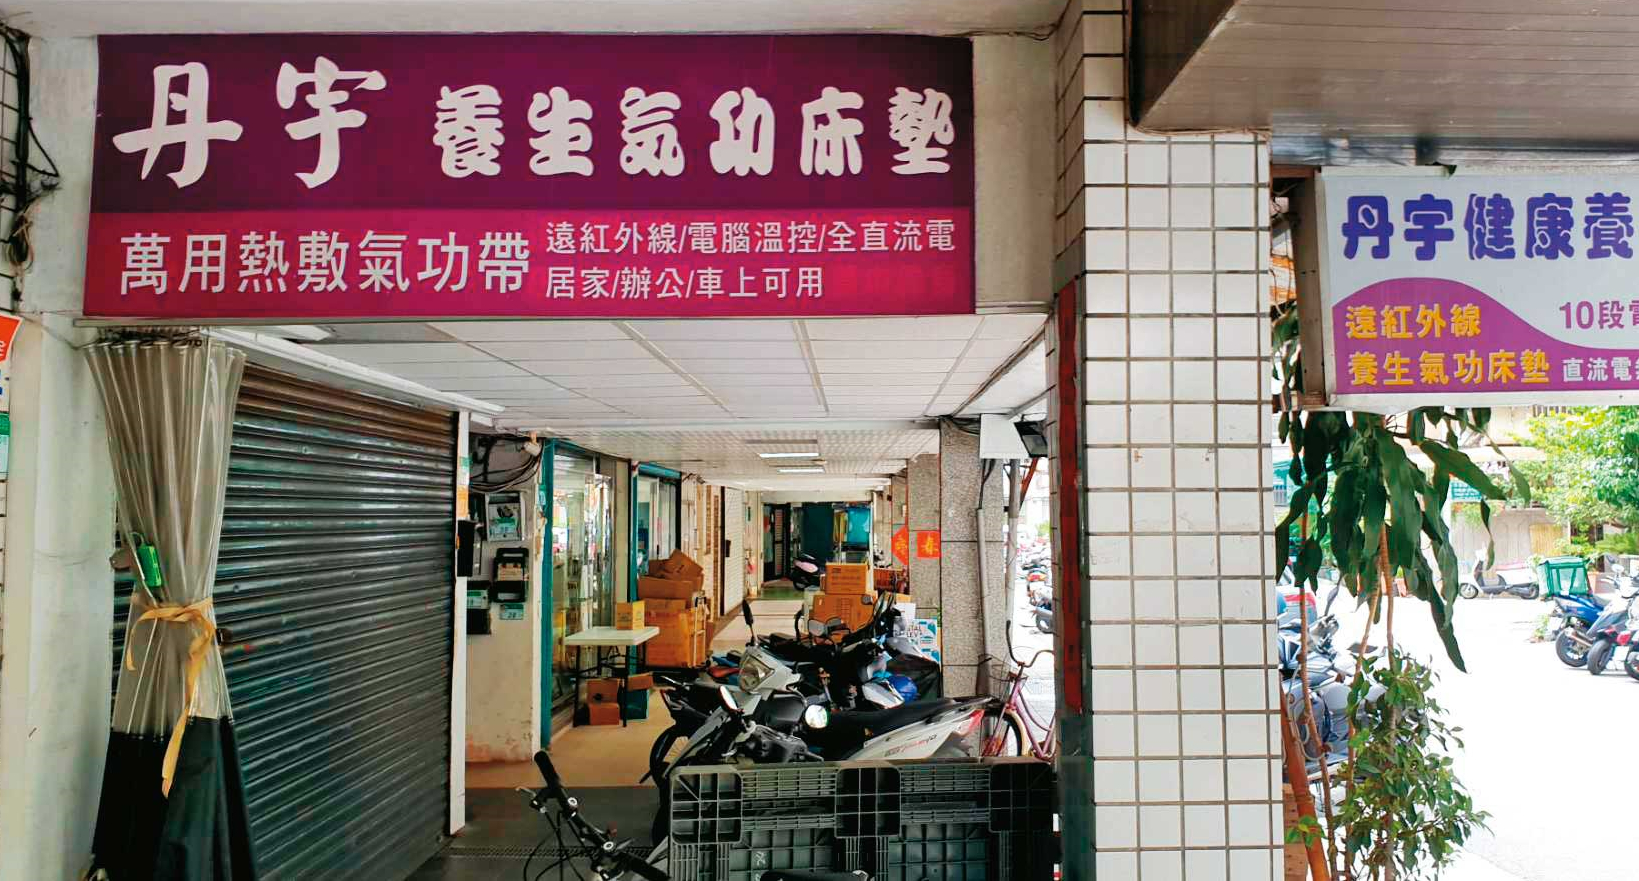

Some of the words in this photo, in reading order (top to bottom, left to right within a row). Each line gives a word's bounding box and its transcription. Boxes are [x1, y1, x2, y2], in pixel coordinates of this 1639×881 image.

[112, 56, 387, 189] 丹宇
[1341, 192, 1634, 261] 丹宇健康養
[120, 231, 530, 296] 萬用熱敷氣功帶
[545, 266, 824, 300] 居家/辦公/車上可用
[1345, 303, 1482, 340] 遠紅外線
[1348, 349, 1551, 386] 養生氣功床墊
[1562, 357, 1639, 382] 直流電
